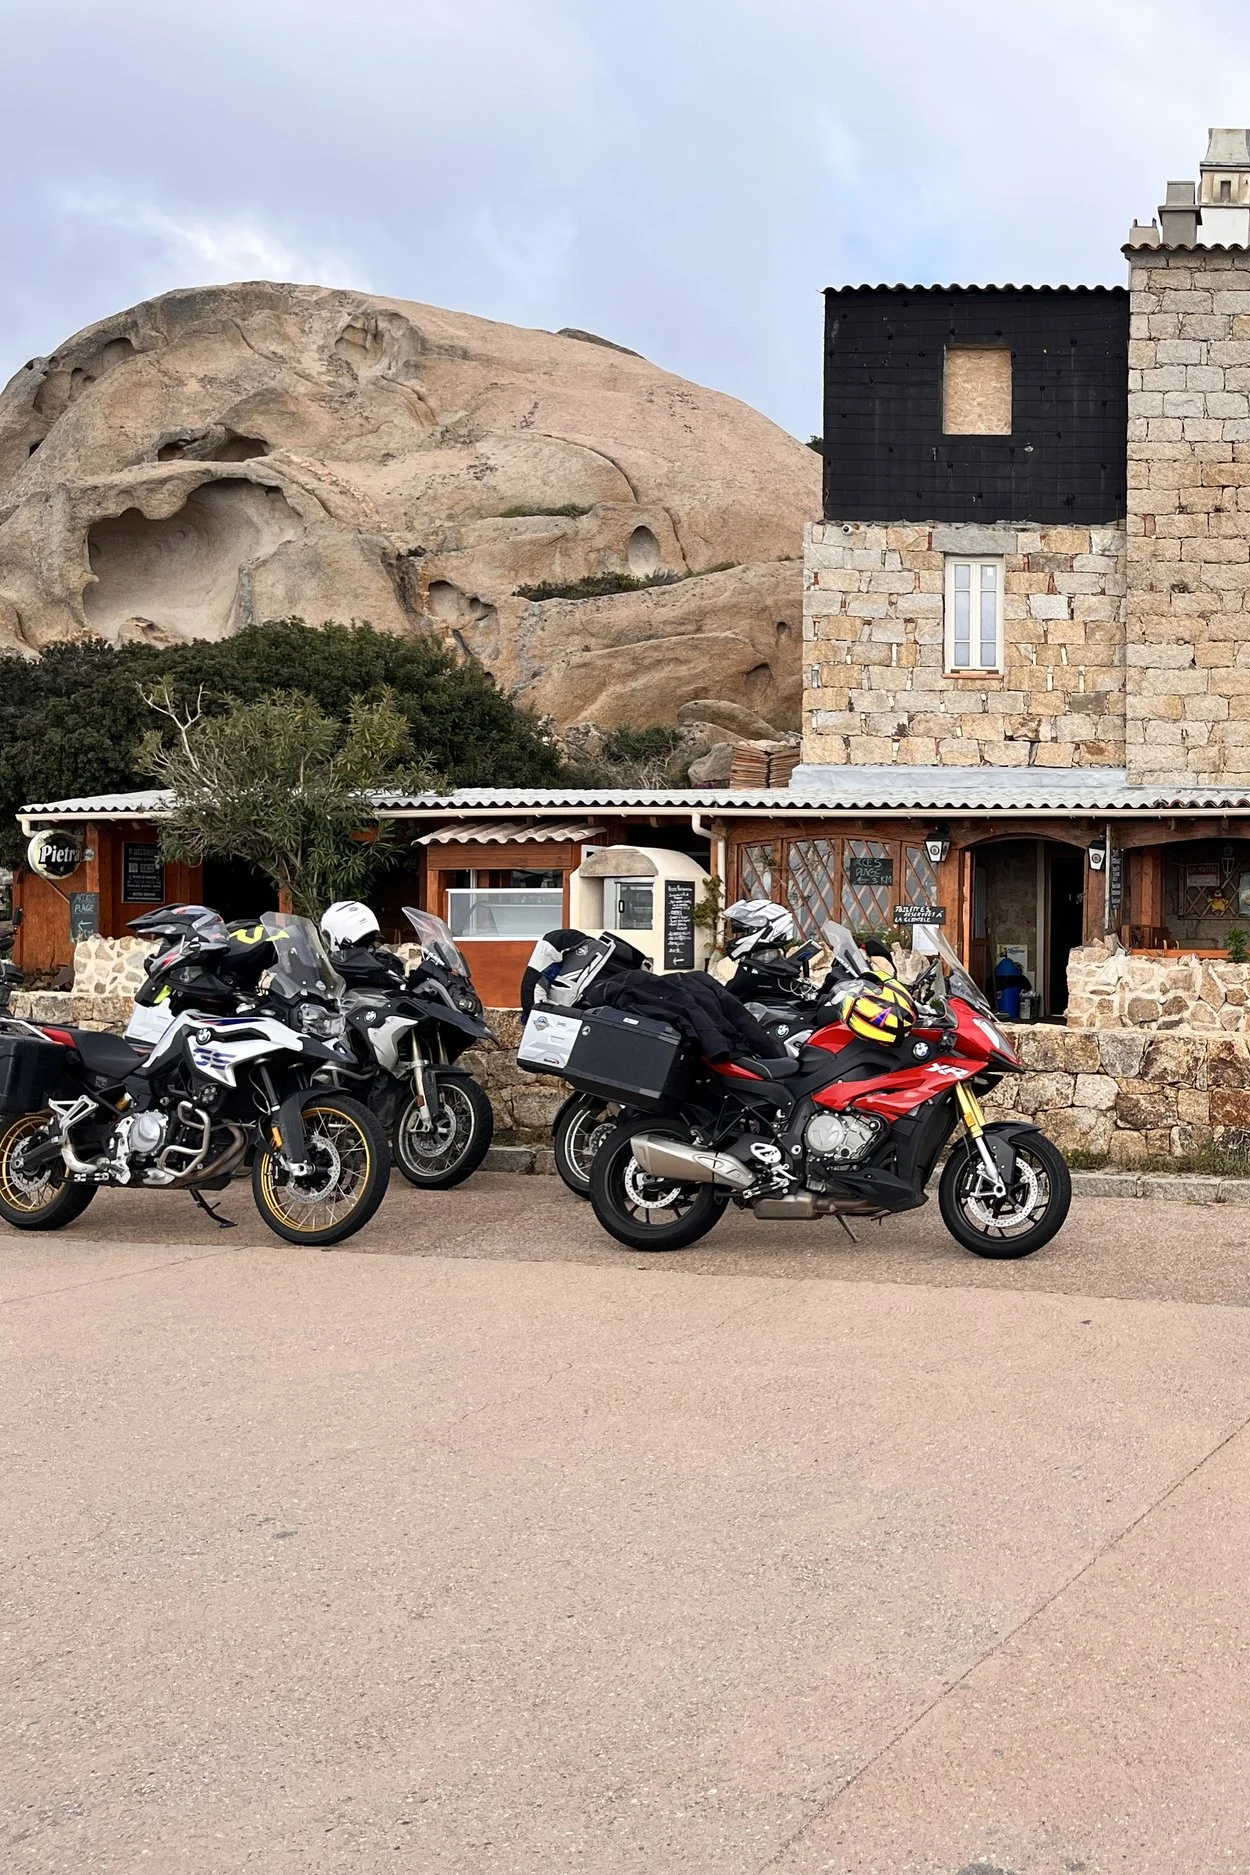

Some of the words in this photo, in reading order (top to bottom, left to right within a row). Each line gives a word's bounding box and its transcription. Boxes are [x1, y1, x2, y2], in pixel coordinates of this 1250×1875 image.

[40, 844, 81, 862] Pietra
[855, 867, 881, 878] PLAGE
[880, 875, 892, 885] KM
[74, 903, 95, 914] PLAGE
[925, 1062, 970, 1079] XR
